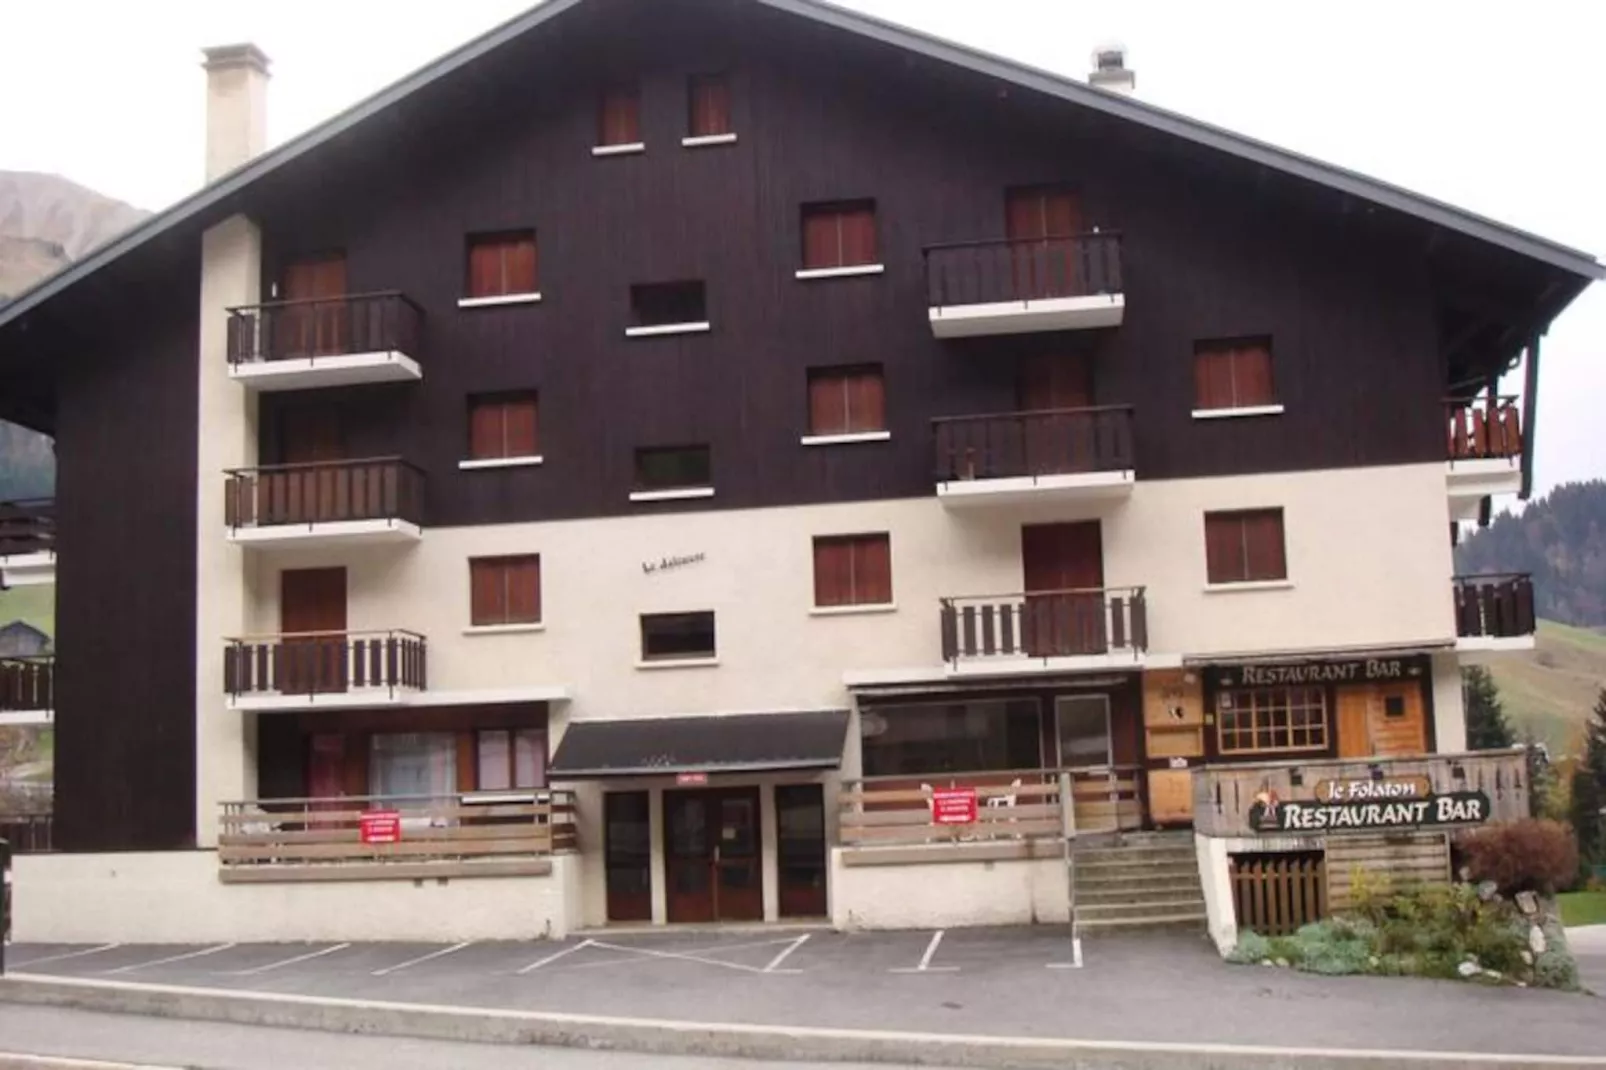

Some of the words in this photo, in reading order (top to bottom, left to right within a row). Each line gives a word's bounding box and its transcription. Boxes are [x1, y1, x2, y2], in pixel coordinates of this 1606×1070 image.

[1242, 663, 1360, 685] RESTAURANT
[1365, 659, 1401, 679] BAR
[1284, 801, 1429, 829] RESTAURANT
[1436, 797, 1481, 821] BAR
